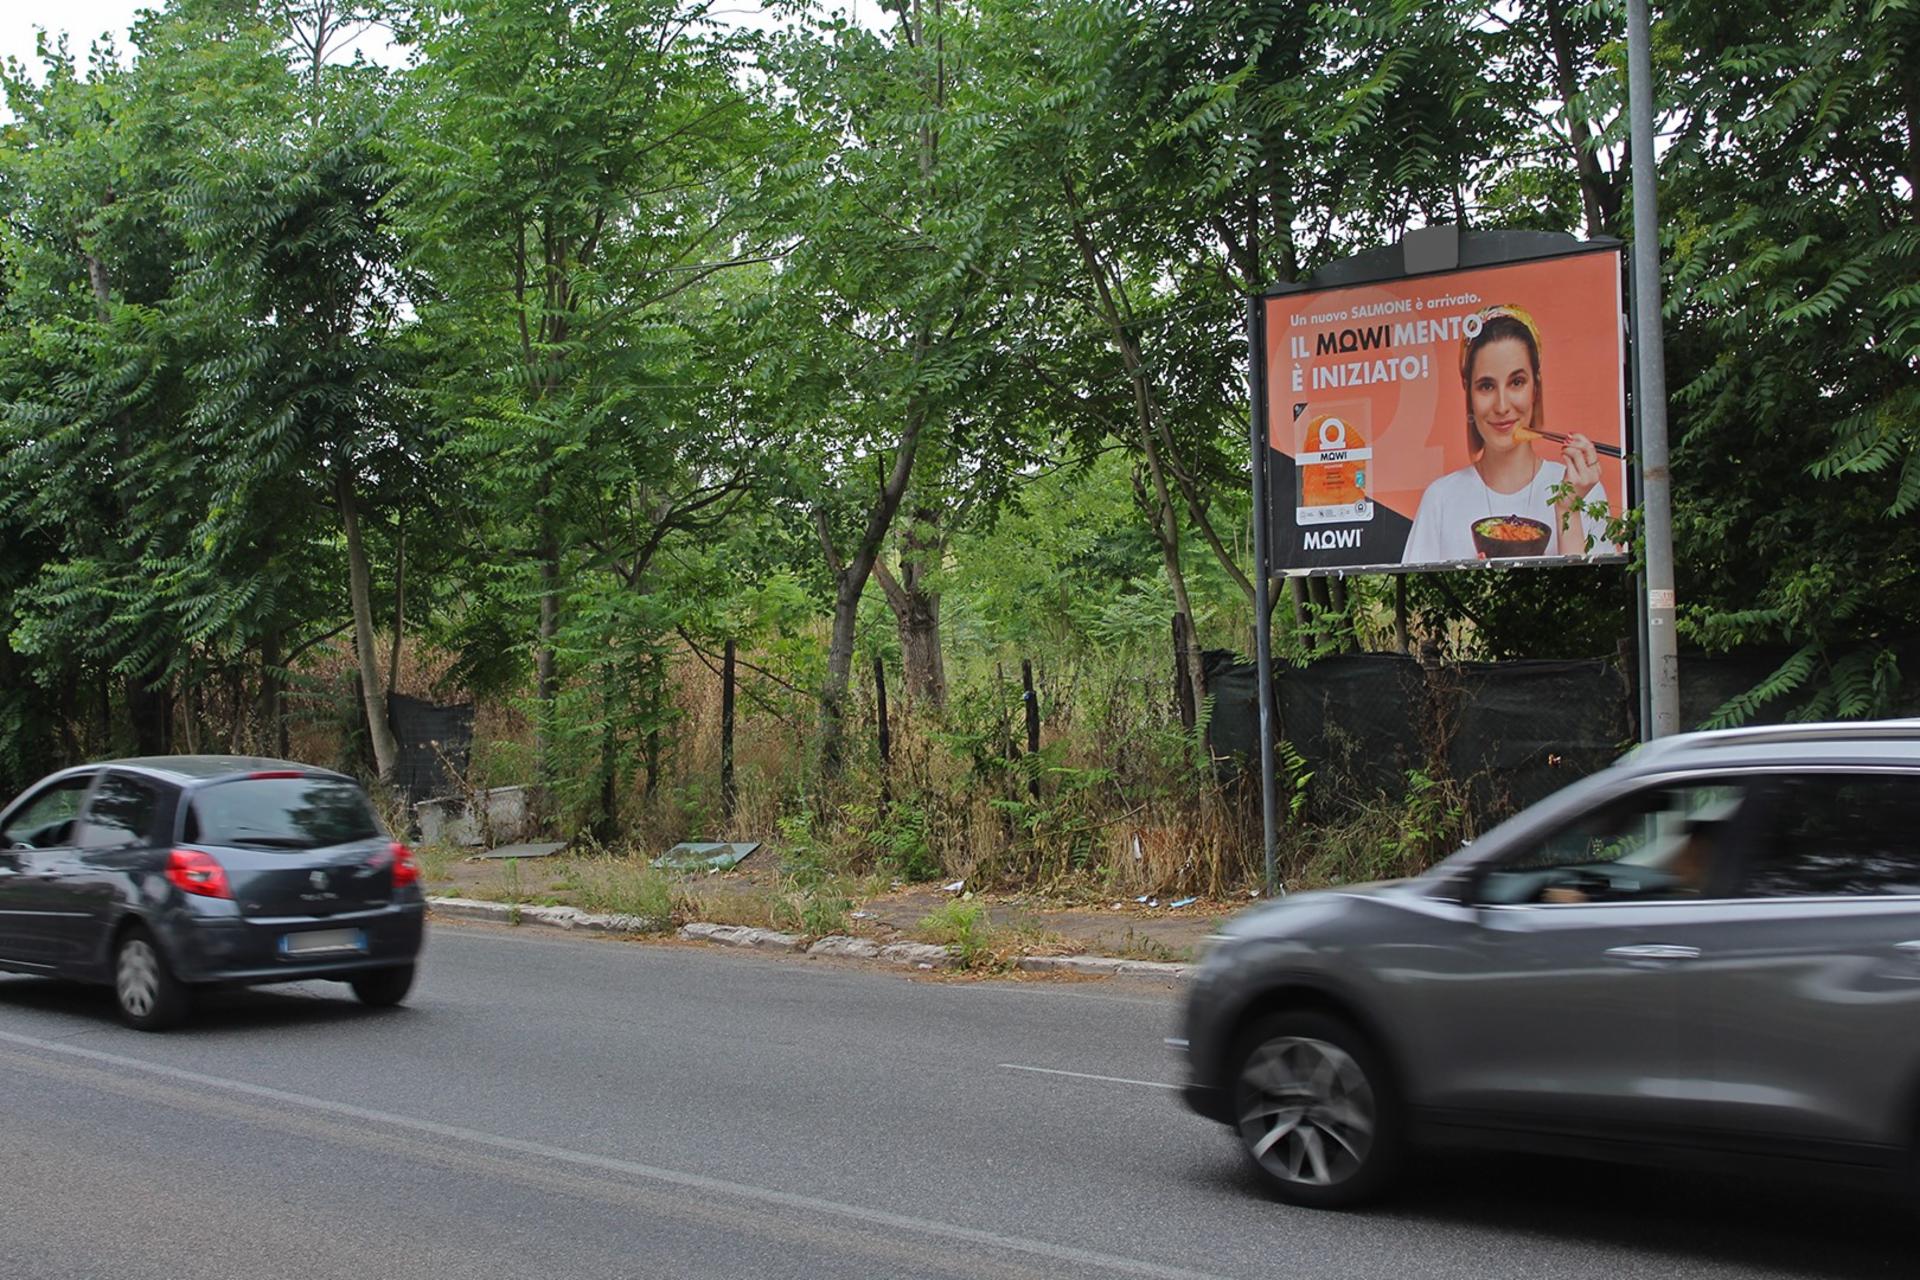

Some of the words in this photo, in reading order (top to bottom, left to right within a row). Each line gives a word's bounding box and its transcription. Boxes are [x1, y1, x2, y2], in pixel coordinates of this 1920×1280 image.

[1290, 314, 1307, 327] Un
[1311, 311, 1347, 324] nuovo
[1351, 299, 1412, 319] SALMONE
[1415, 297, 1423, 311] è
[1427, 293, 1482, 309] arrivato.
[1291, 336, 1310, 359] IL
[1291, 363, 1303, 392] È
[1312, 354, 1429, 390] INIZIATO!
[1320, 451, 1347, 462] MOWI
[1303, 528, 1362, 551] MOWI
